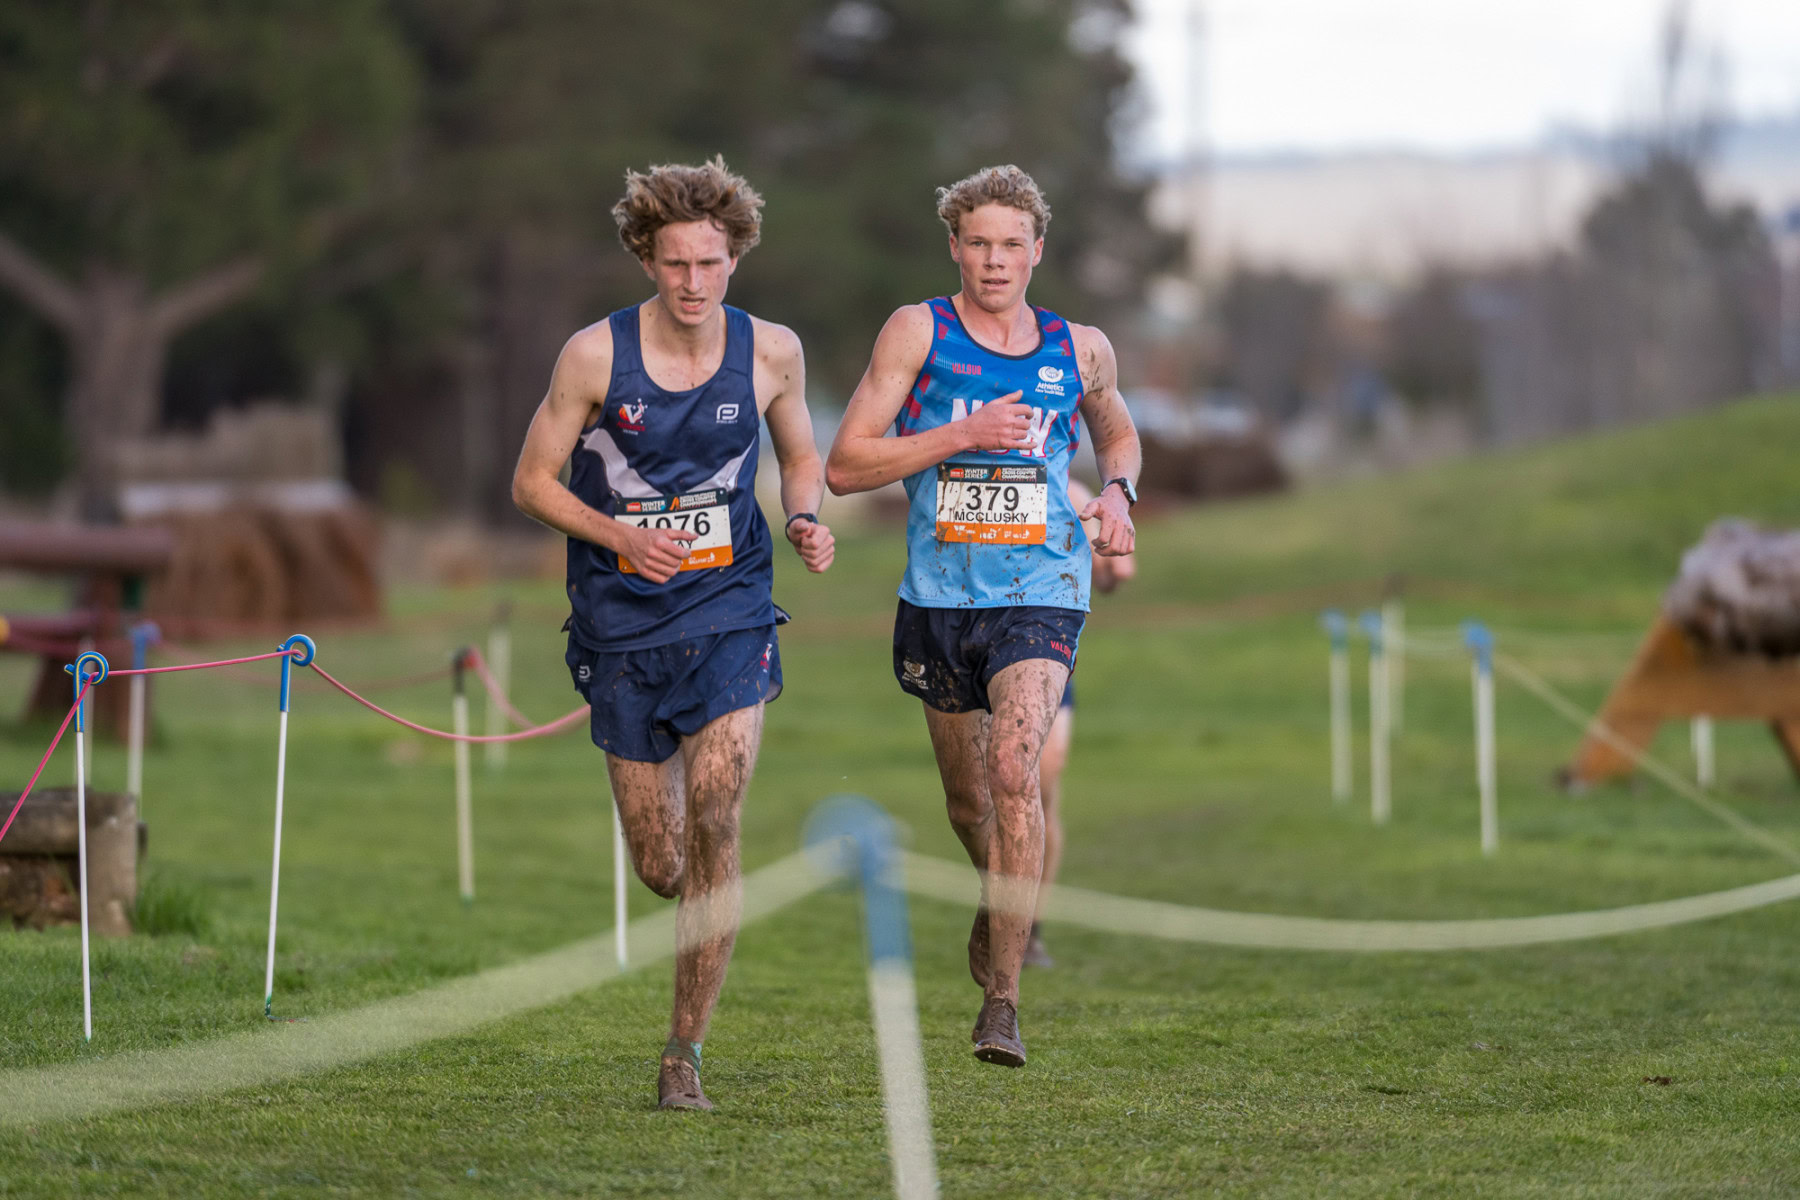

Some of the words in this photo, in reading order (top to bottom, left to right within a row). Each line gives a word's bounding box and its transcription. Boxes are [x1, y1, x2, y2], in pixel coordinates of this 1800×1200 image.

[1036, 382, 1065, 392] Athletics
[951, 398, 1059, 458] NW
[966, 485, 1019, 511] 379
[955, 511, 1029, 523] MCCLUSKY
